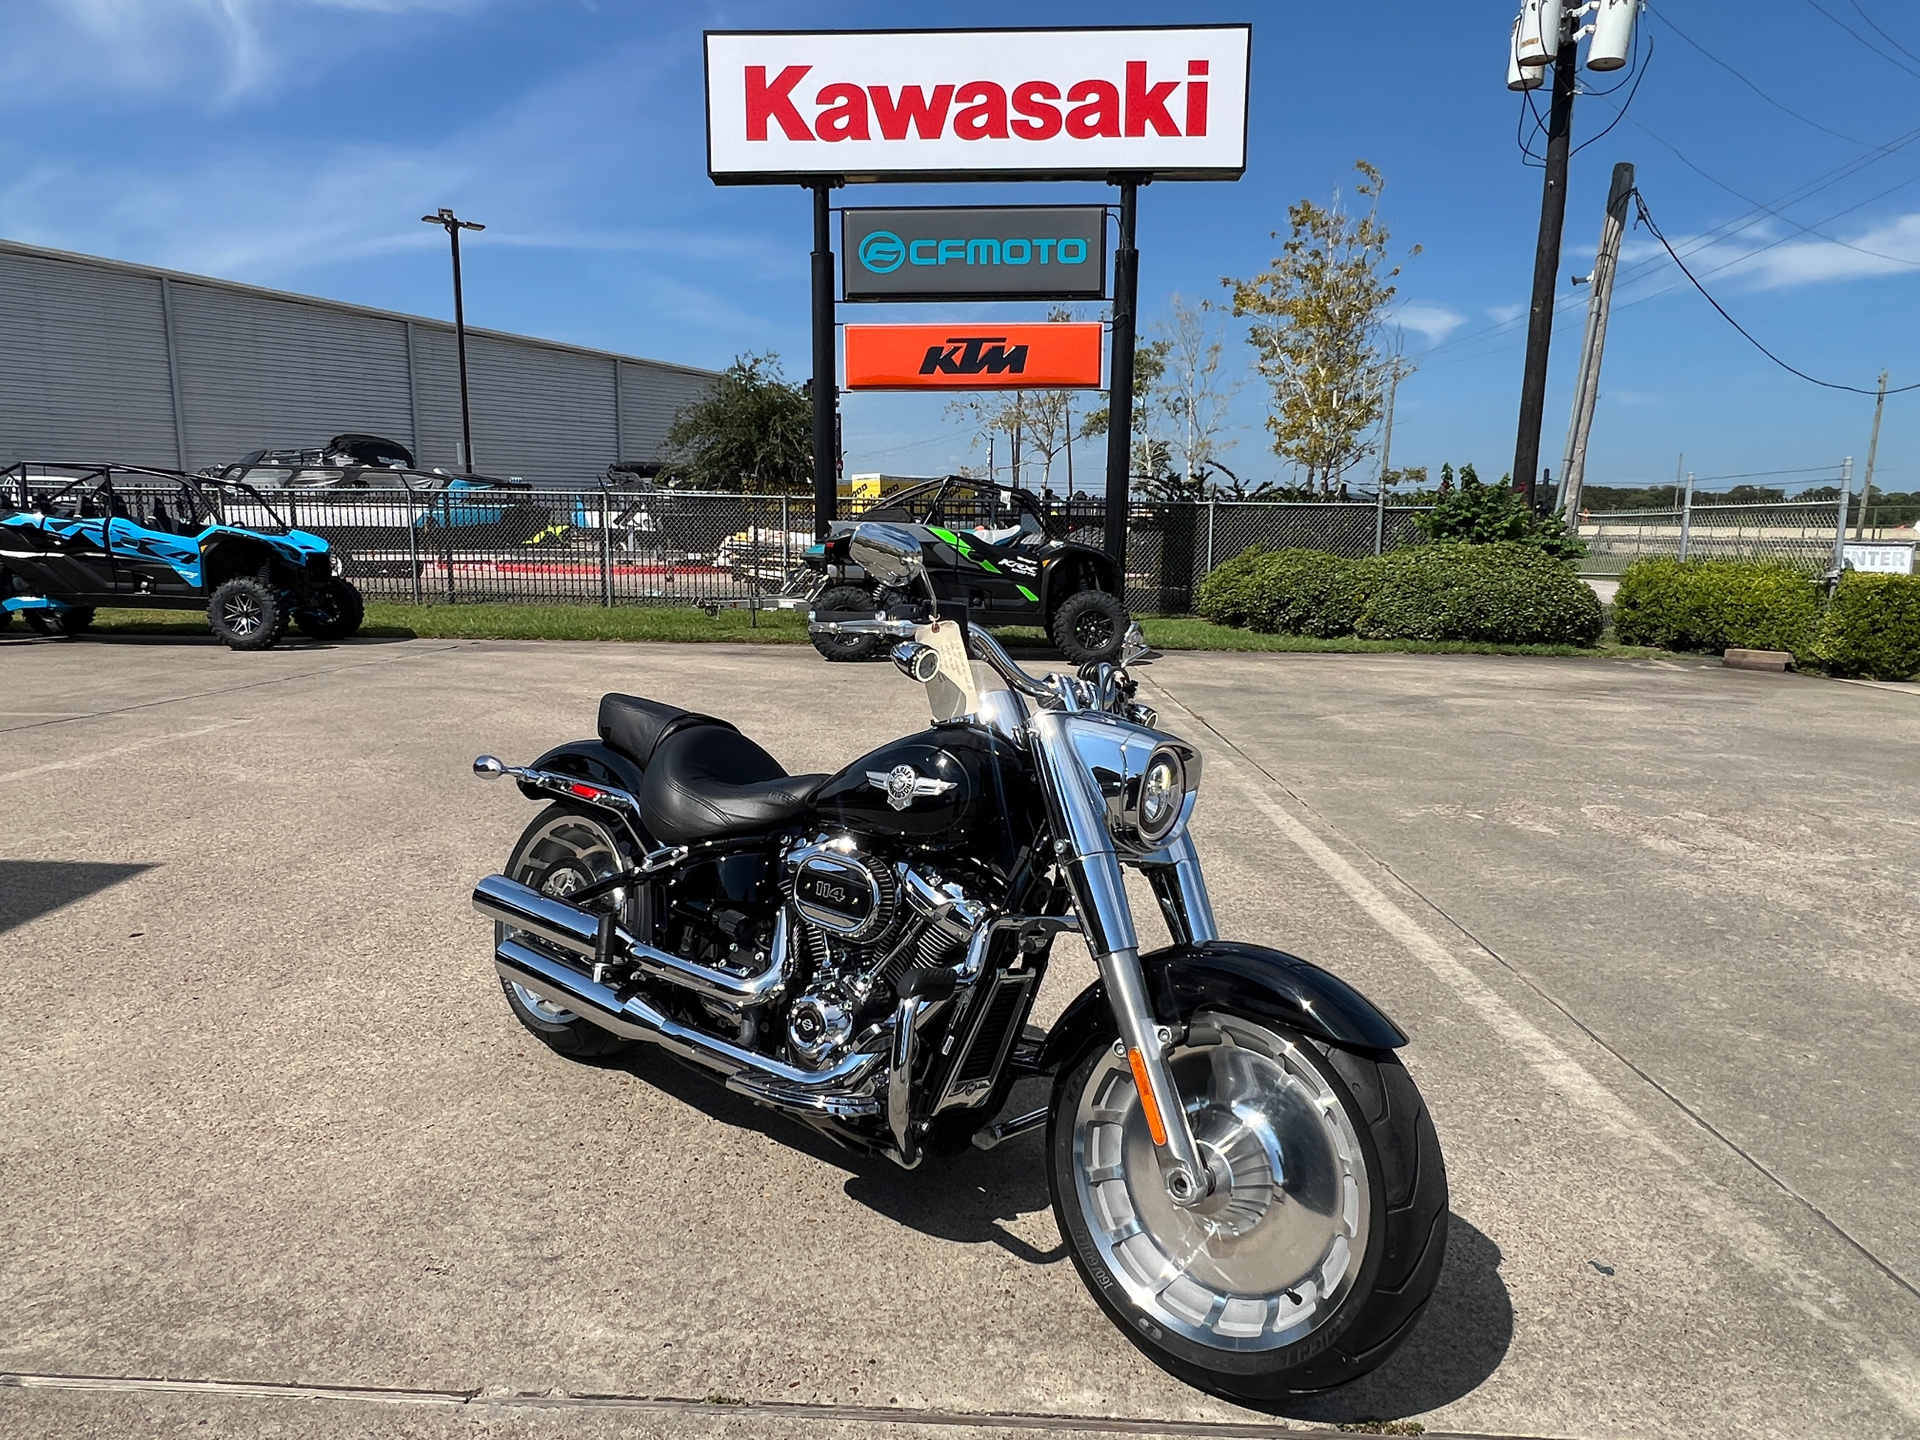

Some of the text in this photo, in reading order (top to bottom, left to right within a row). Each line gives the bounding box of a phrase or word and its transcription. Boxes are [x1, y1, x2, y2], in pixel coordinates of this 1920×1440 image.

[744, 59, 1210, 142] Kawasaki
[909, 238, 1087, 266] CFMOTO
[918, 337, 1029, 375] KTM
[815, 880, 846, 903] 114
